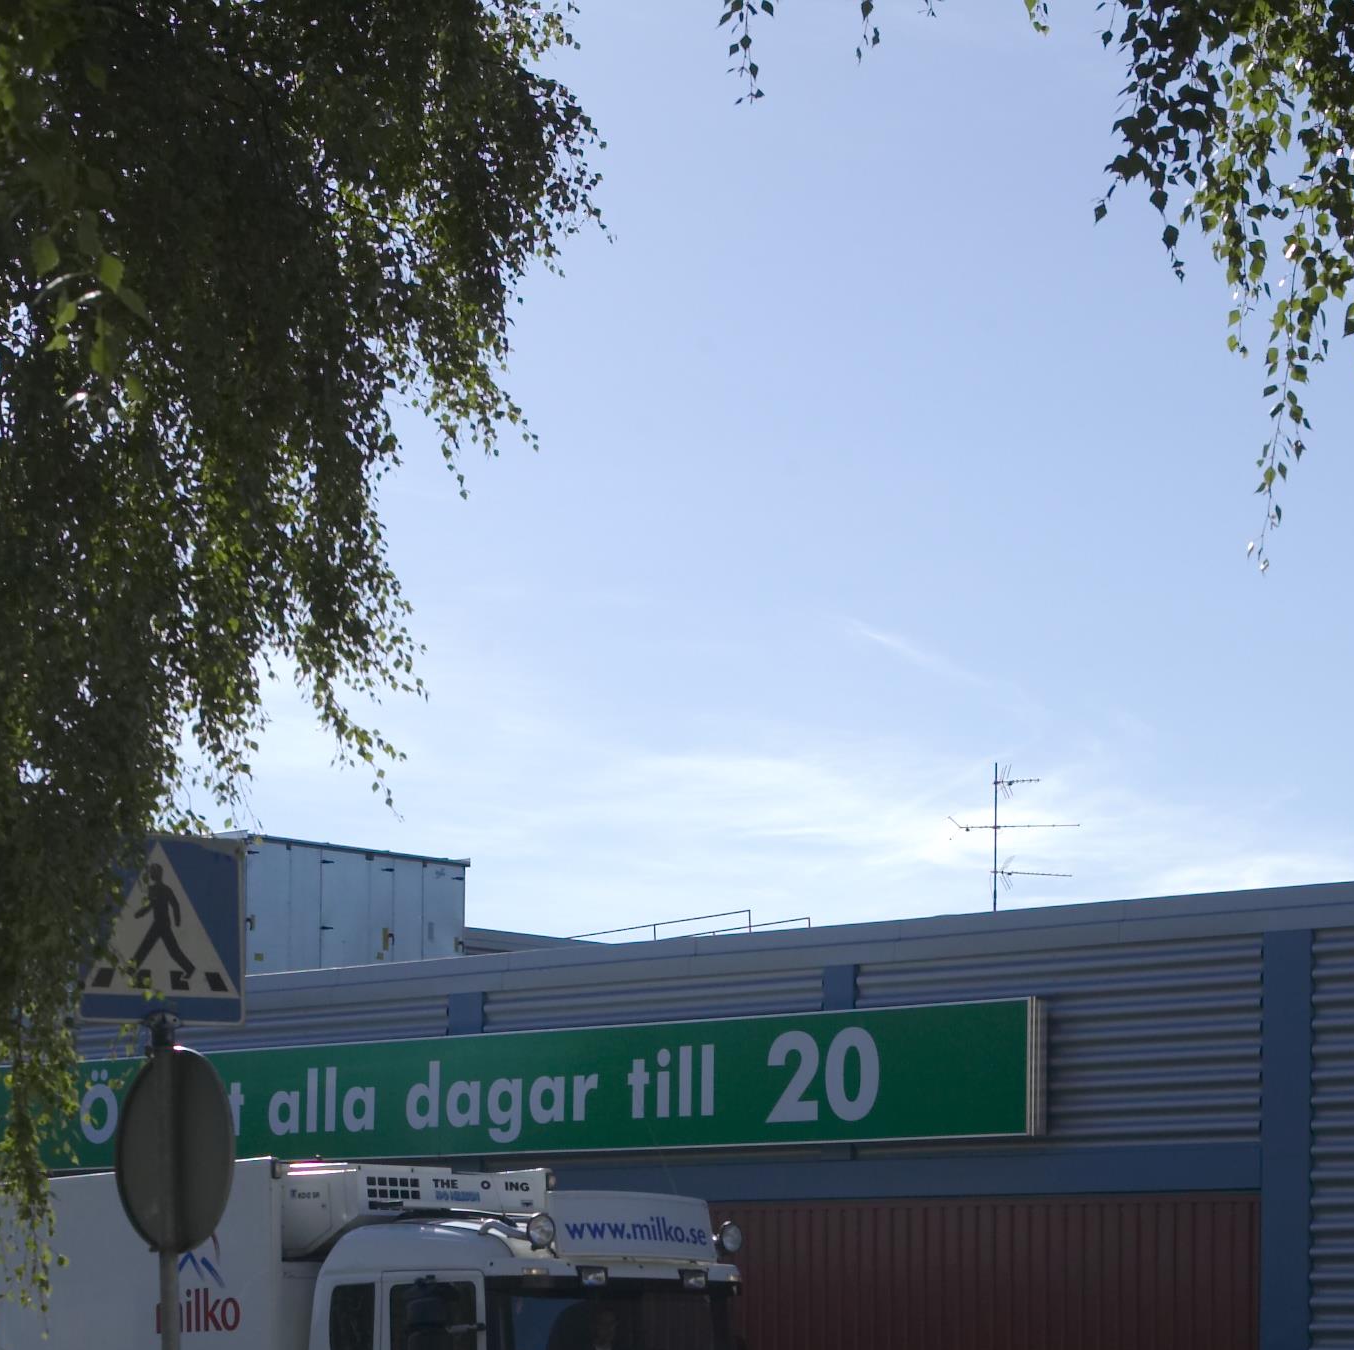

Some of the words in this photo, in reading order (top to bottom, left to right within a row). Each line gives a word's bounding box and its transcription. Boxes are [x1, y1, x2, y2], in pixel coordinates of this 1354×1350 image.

[268, 1066, 376, 1136] alla
[406, 1060, 599, 1143] dagar
[627, 1044, 715, 1119] till
[765, 1026, 880, 1124] 20
[432, 1178, 459, 1189] THE
[564, 1216, 707, 1246] www.milko.se
